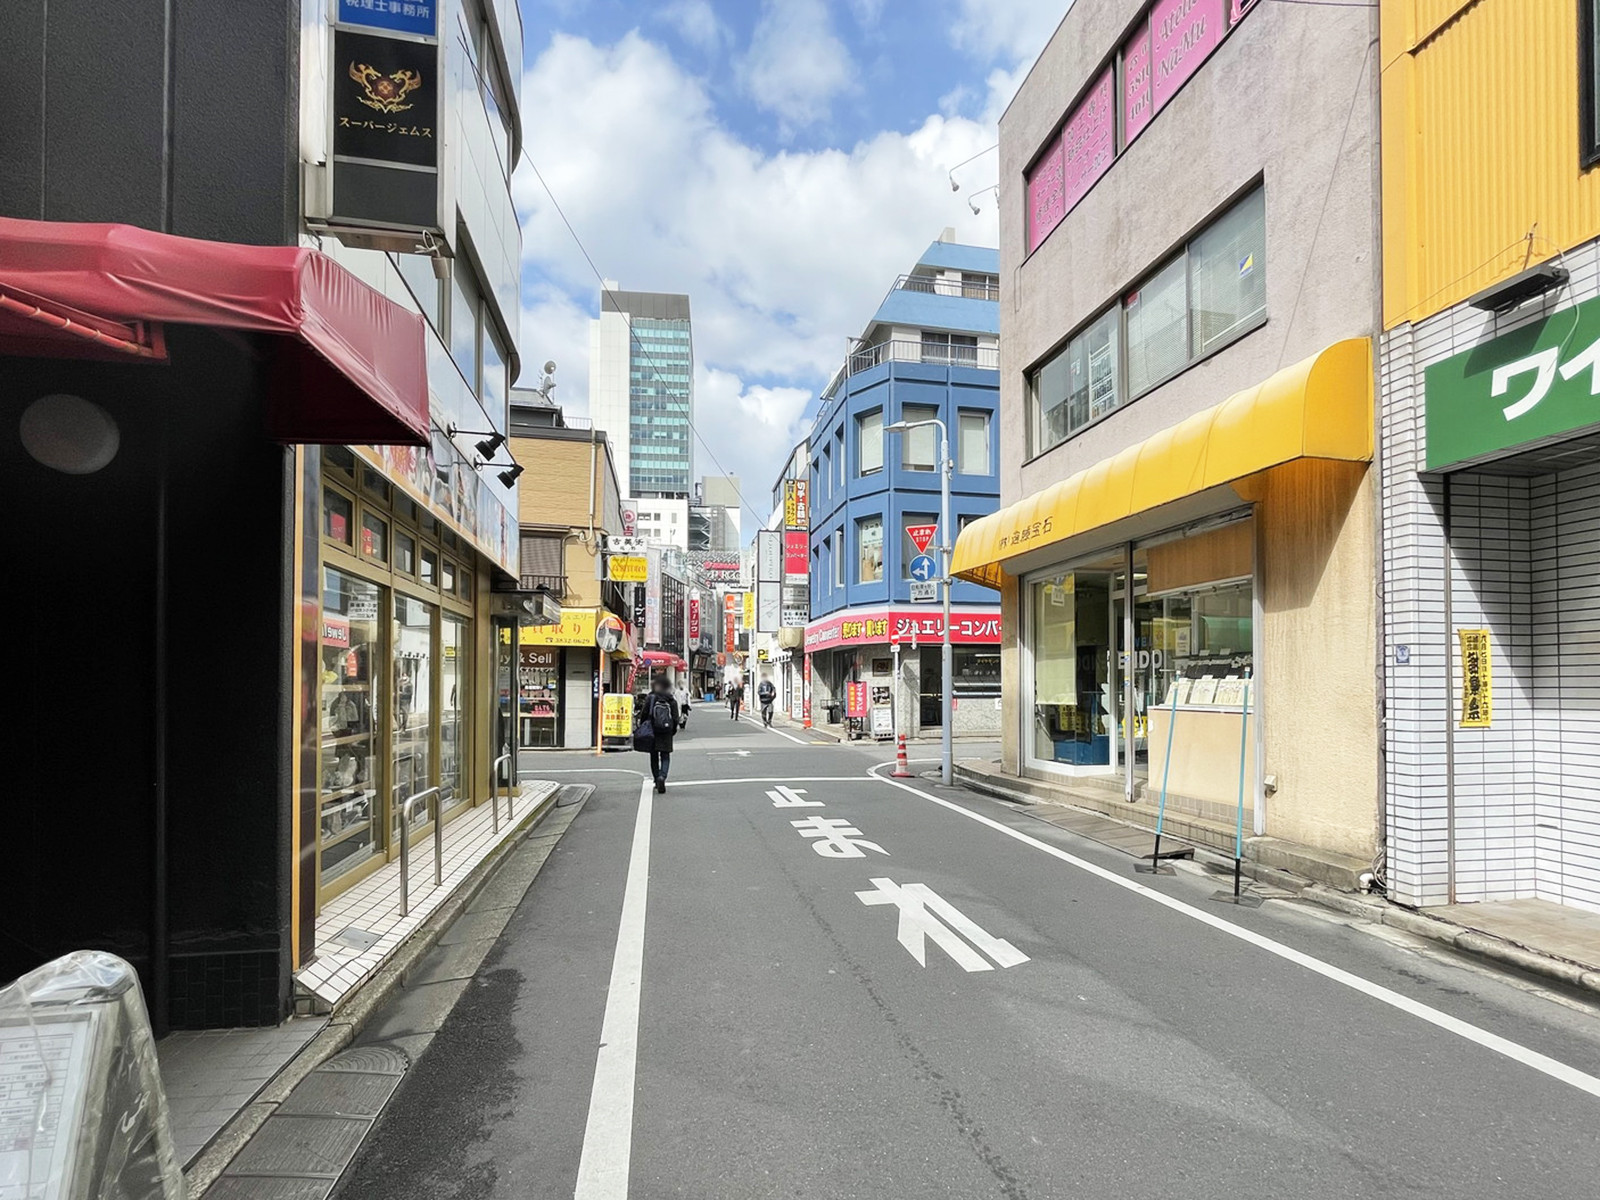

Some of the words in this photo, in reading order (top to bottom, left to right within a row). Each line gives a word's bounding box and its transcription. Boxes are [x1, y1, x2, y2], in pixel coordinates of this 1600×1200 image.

[339, 116, 432, 138] スーパージェムス
[913, 528, 931, 536] 止まれ
[896, 618, 1001, 637] ジュエリーコンバ
[528, 652, 552, 664] Sell
[758, 649, 765, 658] P
